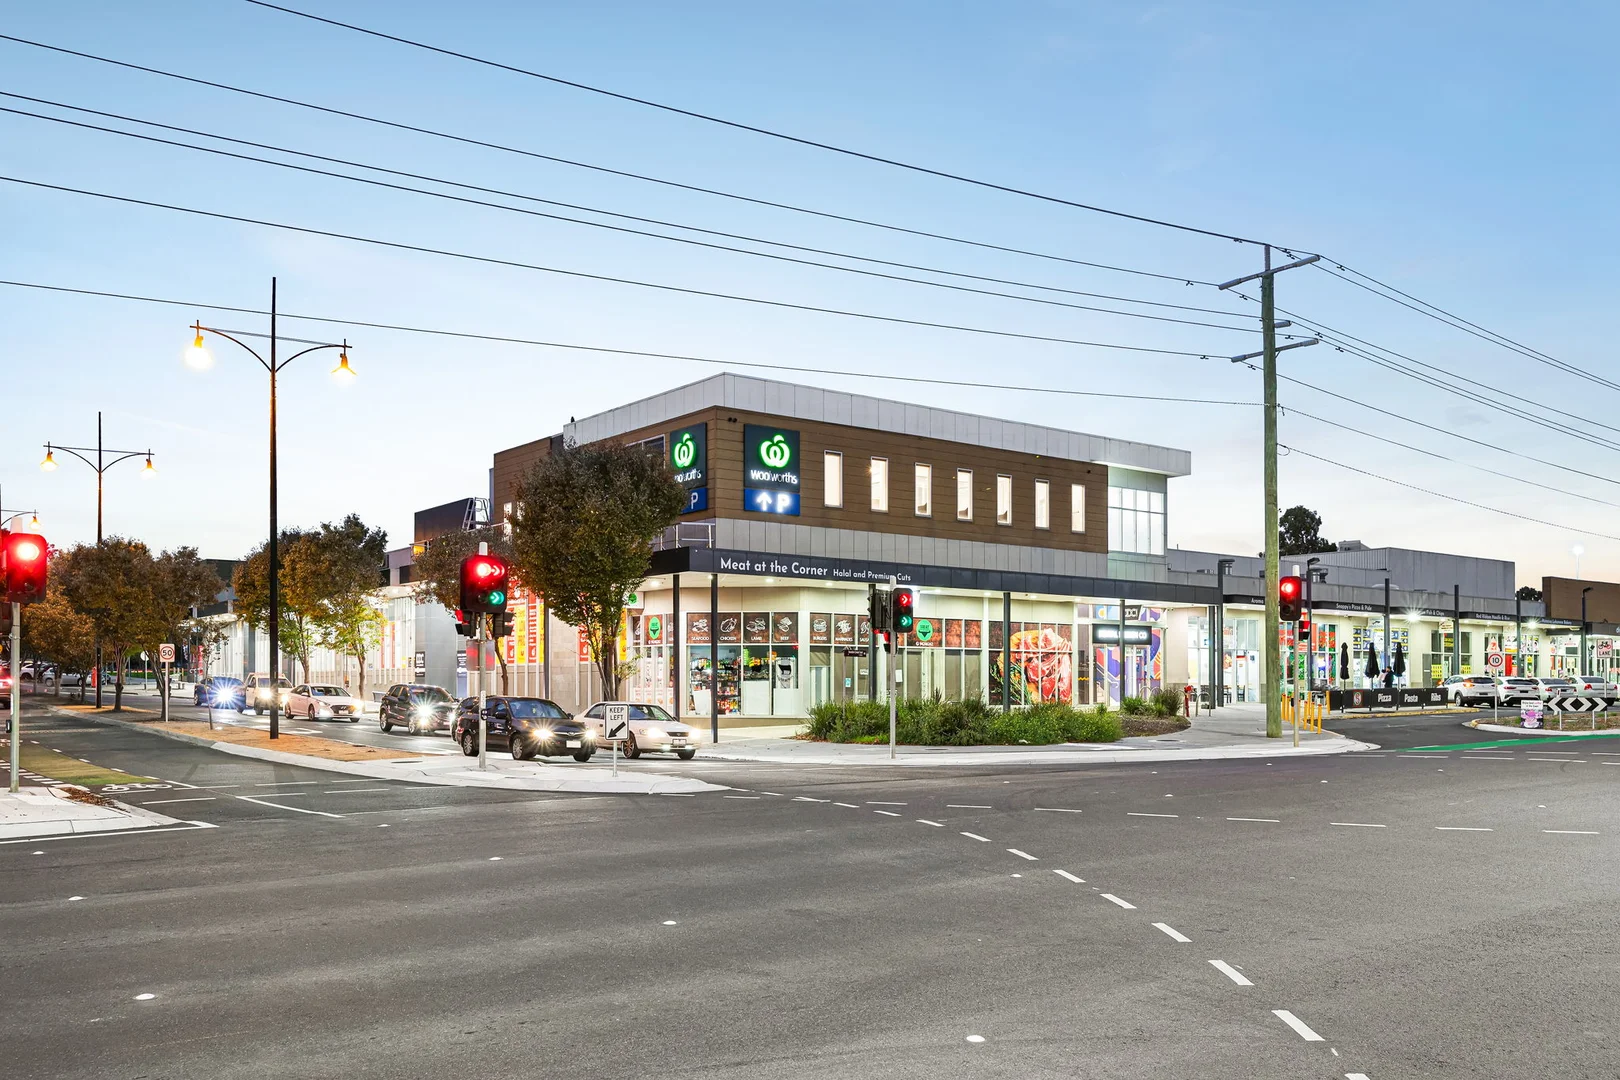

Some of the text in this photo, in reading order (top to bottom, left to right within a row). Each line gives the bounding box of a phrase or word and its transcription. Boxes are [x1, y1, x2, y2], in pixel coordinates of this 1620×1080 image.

[690, 492, 698, 509] P
[776, 494, 790, 512] P
[720, 557, 828, 576] Meat at the Corner
[833, 568, 911, 581] Halal and Premium Cuts
[162, 649, 173, 657] 50
[1377, 693, 1392, 703] Pizza
[1404, 693, 1418, 703] Pasta
[1430, 692, 1442, 702] Ribs
